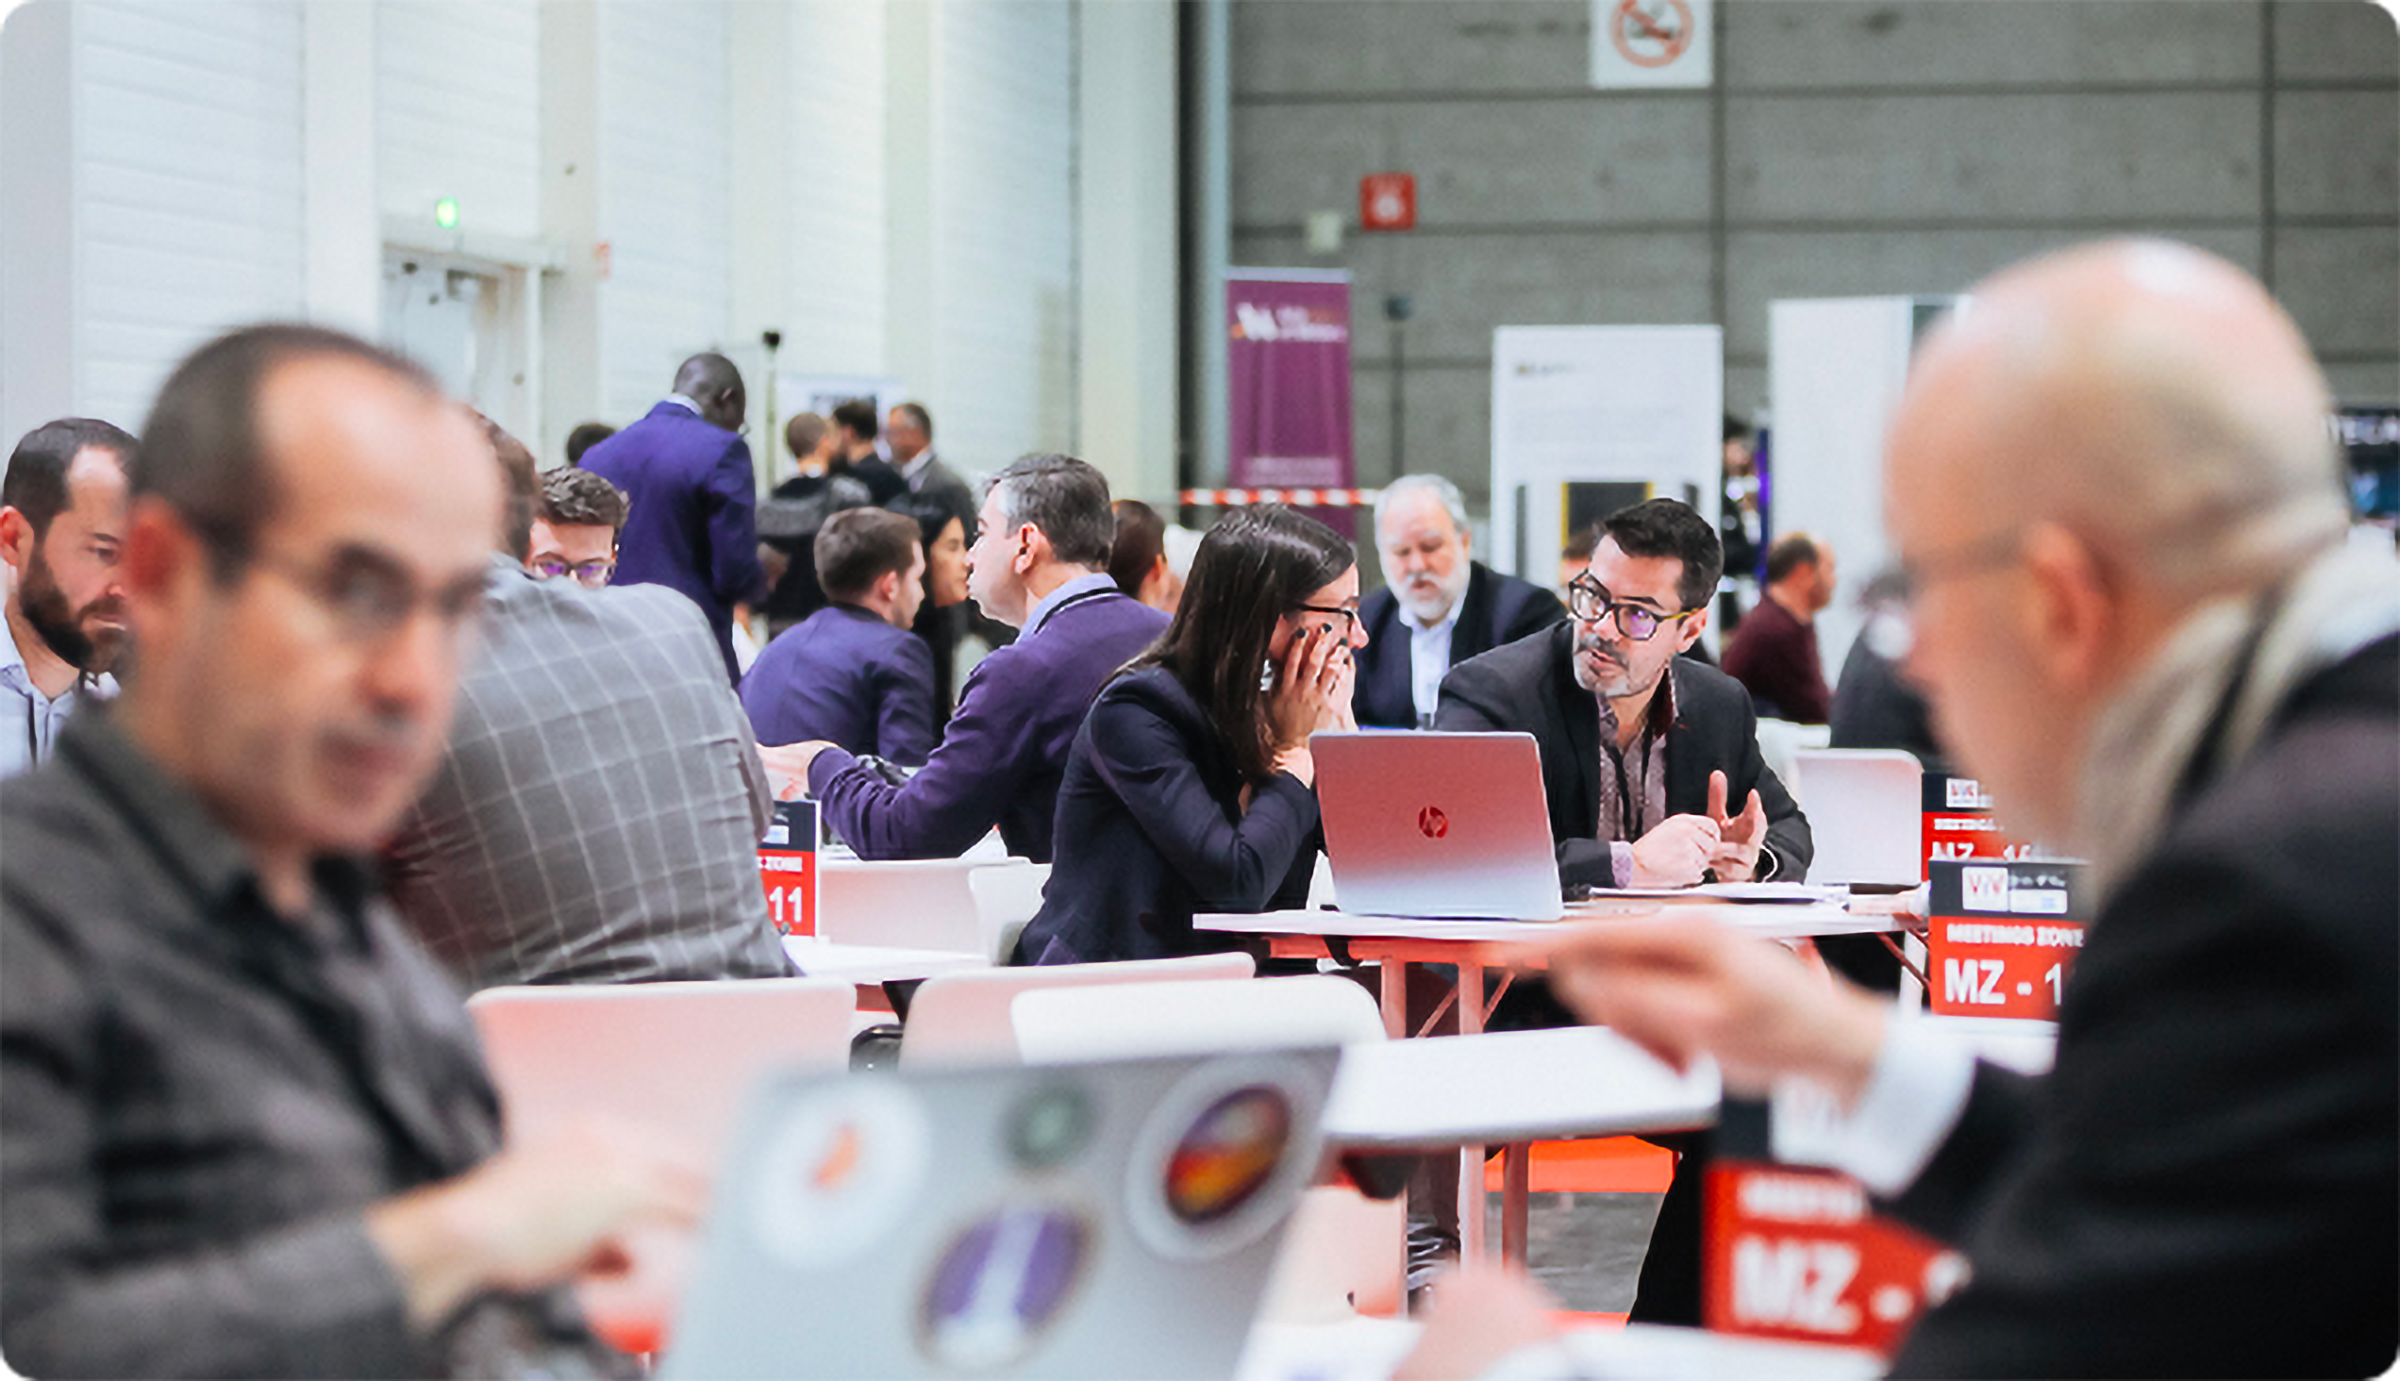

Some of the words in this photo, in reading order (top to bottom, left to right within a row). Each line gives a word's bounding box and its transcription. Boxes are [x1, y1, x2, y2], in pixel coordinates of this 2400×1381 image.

[769, 886, 803, 923] 11
[1947, 923, 2035, 945] MEETINGS
[1944, 958, 2006, 1005] MZ
[1734, 1234, 1863, 1334] MZ
